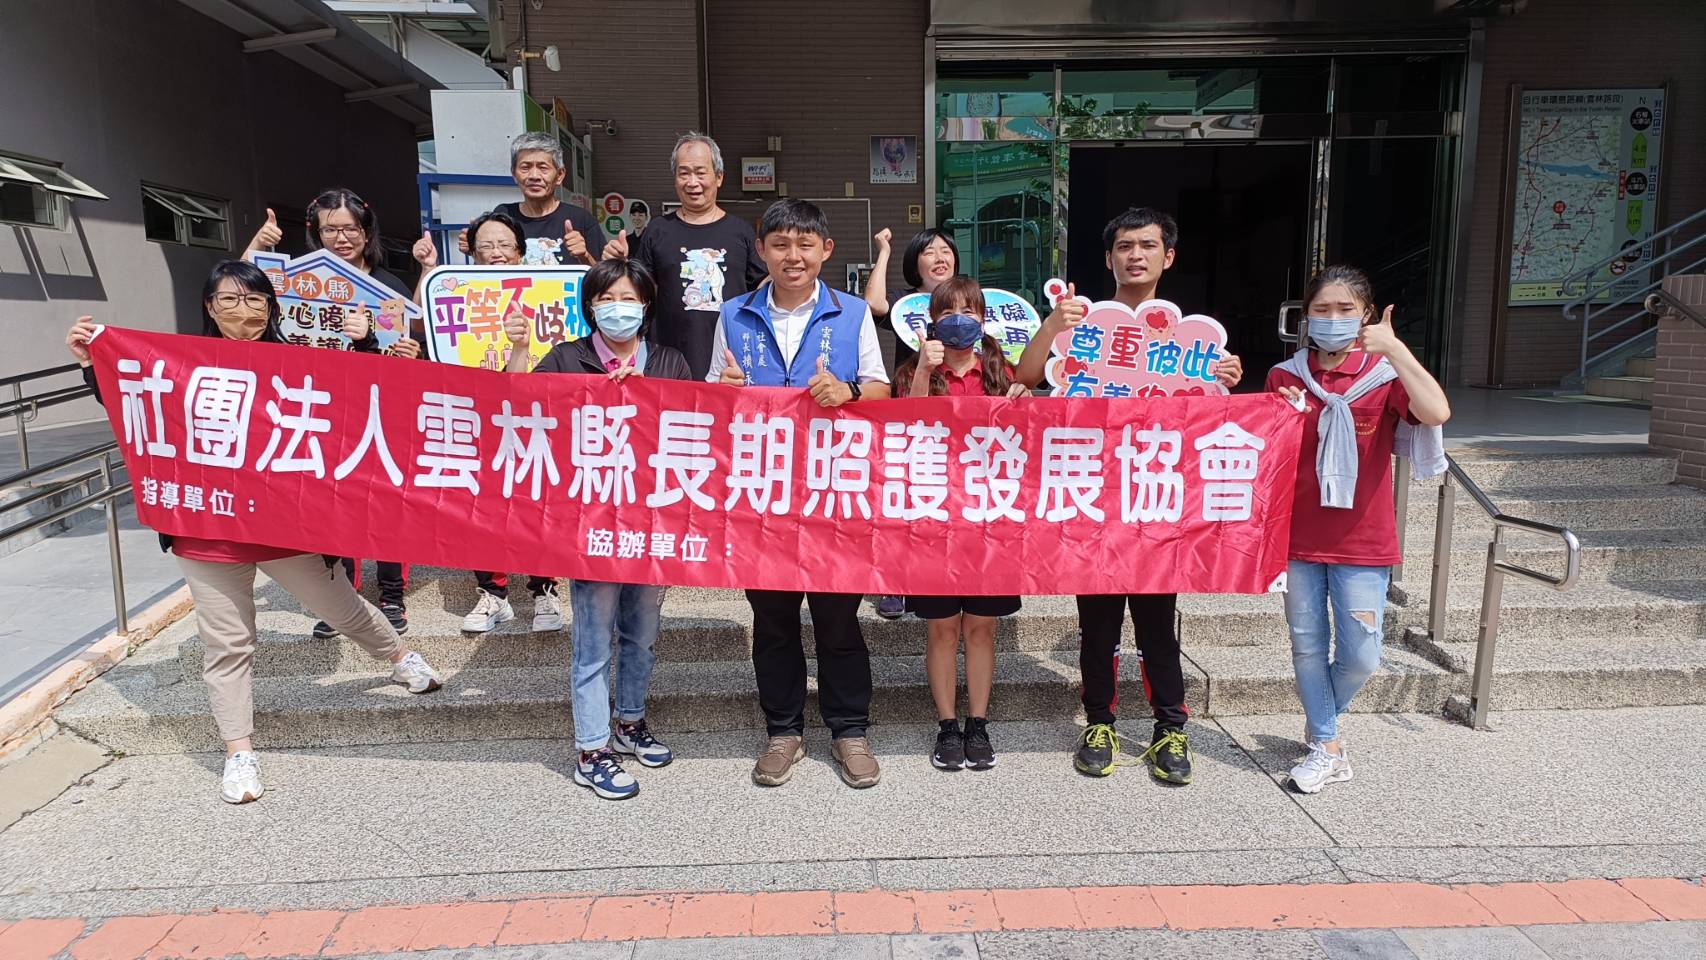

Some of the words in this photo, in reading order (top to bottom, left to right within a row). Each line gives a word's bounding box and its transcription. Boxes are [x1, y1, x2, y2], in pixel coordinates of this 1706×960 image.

[268, 272, 350, 300] 雲林縣
[819, 326, 833, 370] 雲林縣
[1068, 324, 1222, 382] 尊重彼此
[117, 358, 1266, 524] 社團法人雲林縣長期照護發展協會
